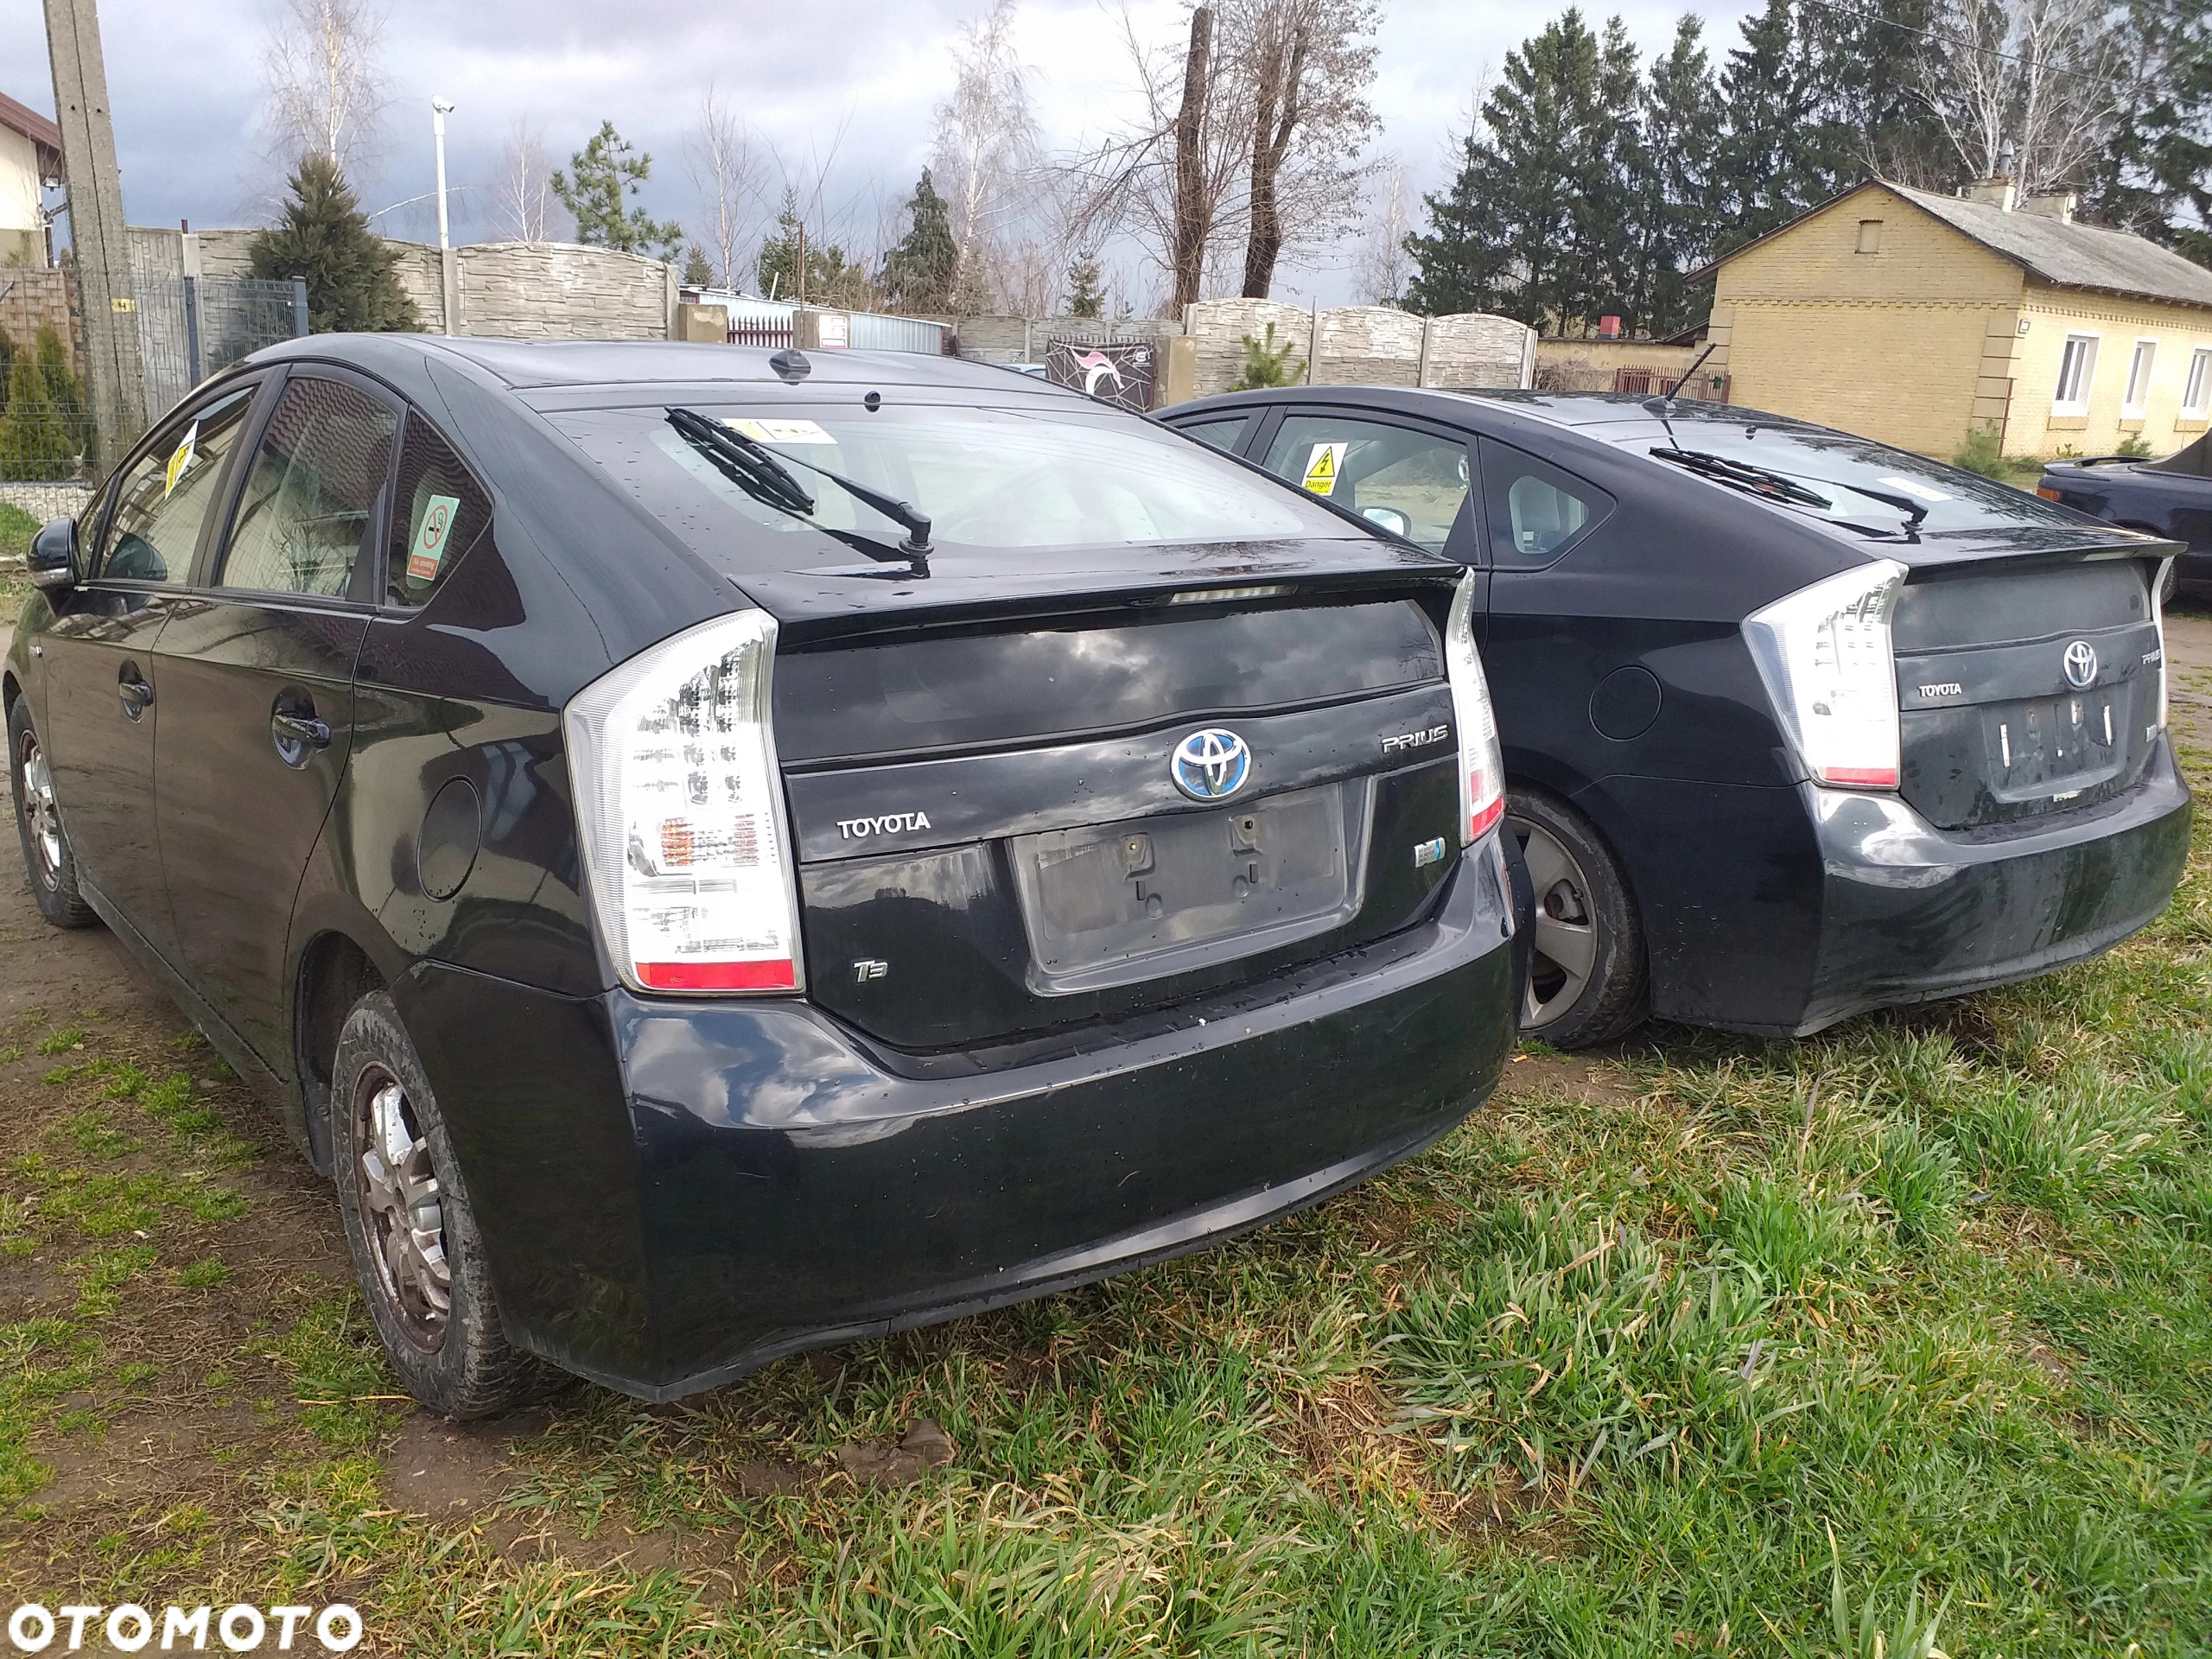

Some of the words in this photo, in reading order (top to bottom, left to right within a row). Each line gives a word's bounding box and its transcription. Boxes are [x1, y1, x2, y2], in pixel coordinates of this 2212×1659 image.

[1305, 480, 1332, 490] Danger
[1918, 683, 1962, 697] TOYOTA
[1382, 724, 1449, 753] PRIUS
[836, 811, 931, 839] TOYOTA
[854, 960, 888, 983] T3
